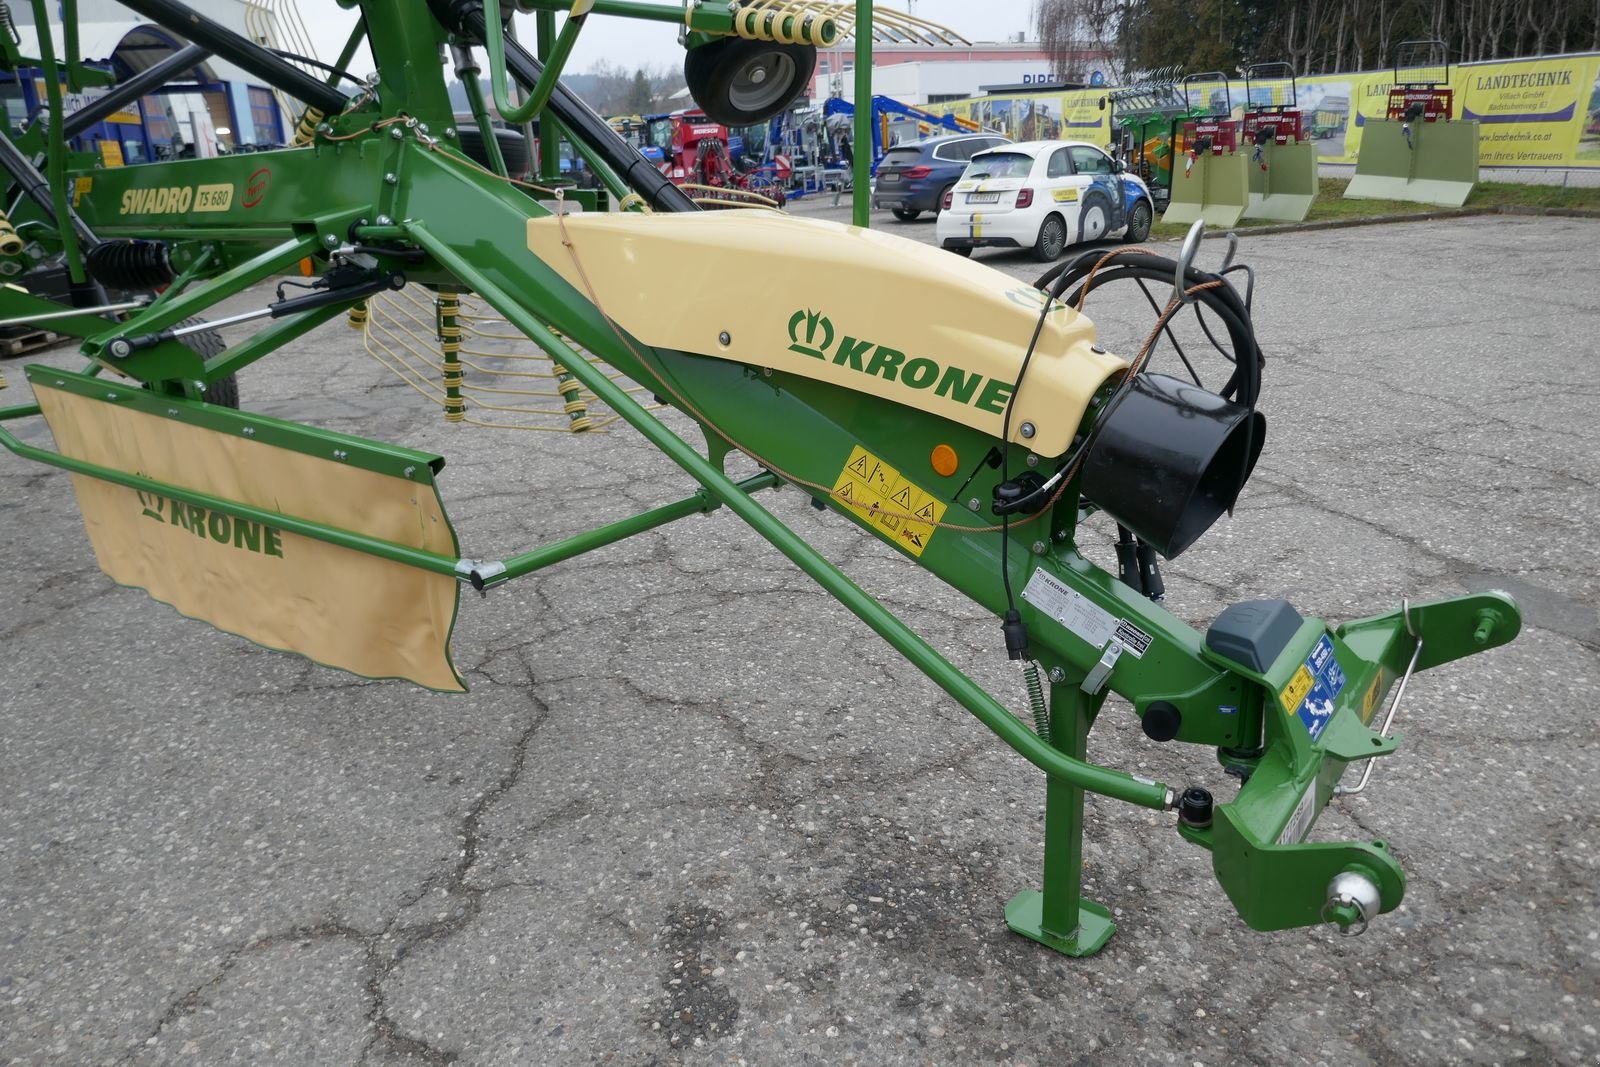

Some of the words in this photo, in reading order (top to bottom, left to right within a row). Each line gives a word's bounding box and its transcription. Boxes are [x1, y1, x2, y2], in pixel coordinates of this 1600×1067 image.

[1476, 71, 1573, 90] LANDTECHNIK
[1479, 132, 1552, 142] ww.landtechnik.co.at
[1494, 151, 1514, 160] Ihres
[1516, 150, 1563, 161] Vertrauens
[119, 186, 193, 215] SWADRO
[199, 192, 209, 207] TS
[211, 190, 229, 206] 680
[832, 336, 1015, 415] KRONE
[170, 501, 284, 559] KRONE
[1044, 578, 1069, 597] KRONE
